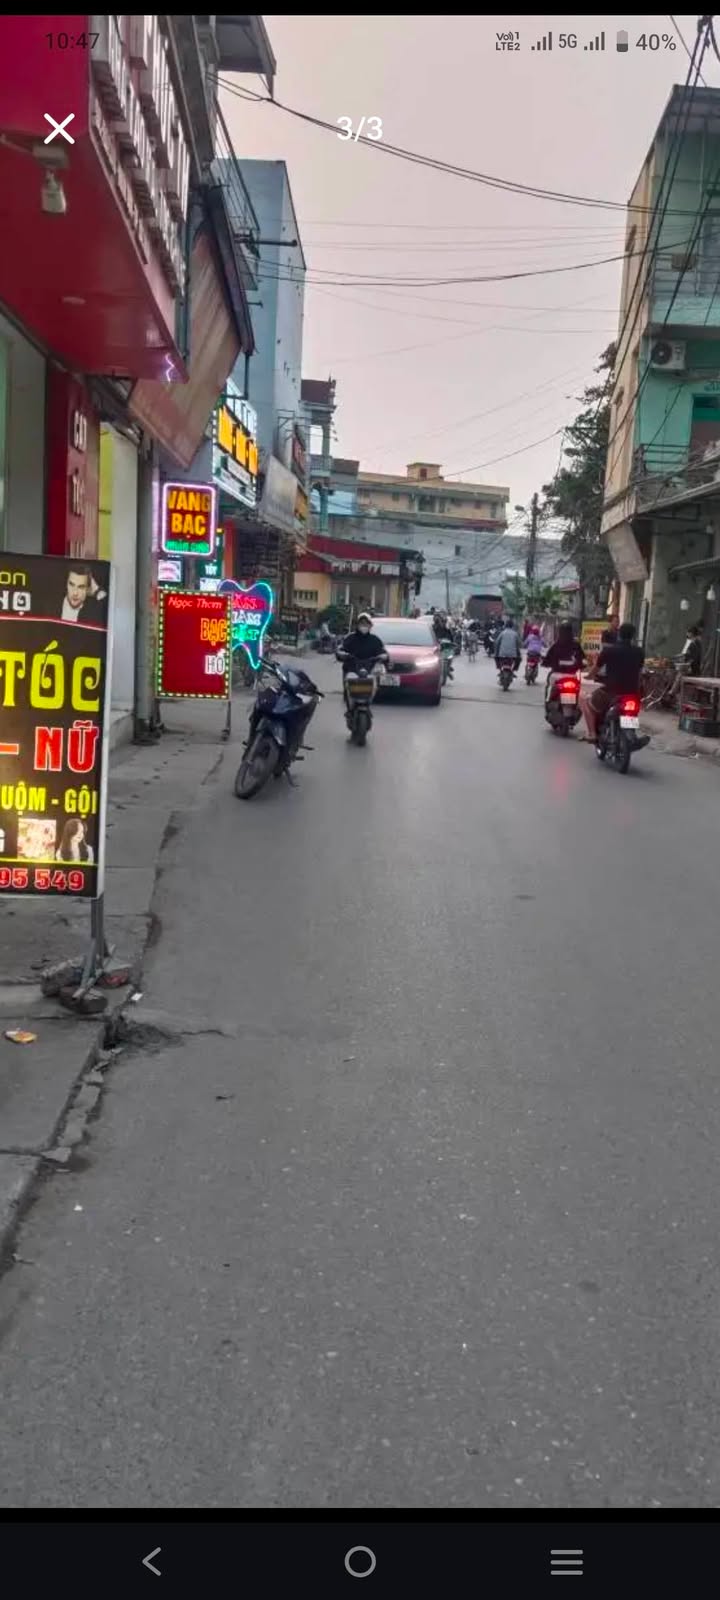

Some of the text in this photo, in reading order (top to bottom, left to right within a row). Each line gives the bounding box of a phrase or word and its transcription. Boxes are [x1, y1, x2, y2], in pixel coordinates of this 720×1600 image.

[0, 640, 101, 713] TÓC
[34, 719, 99, 774] NỮ
[64, 784, 98, 819] GỘI
[34, 868, 85, 891] 549
